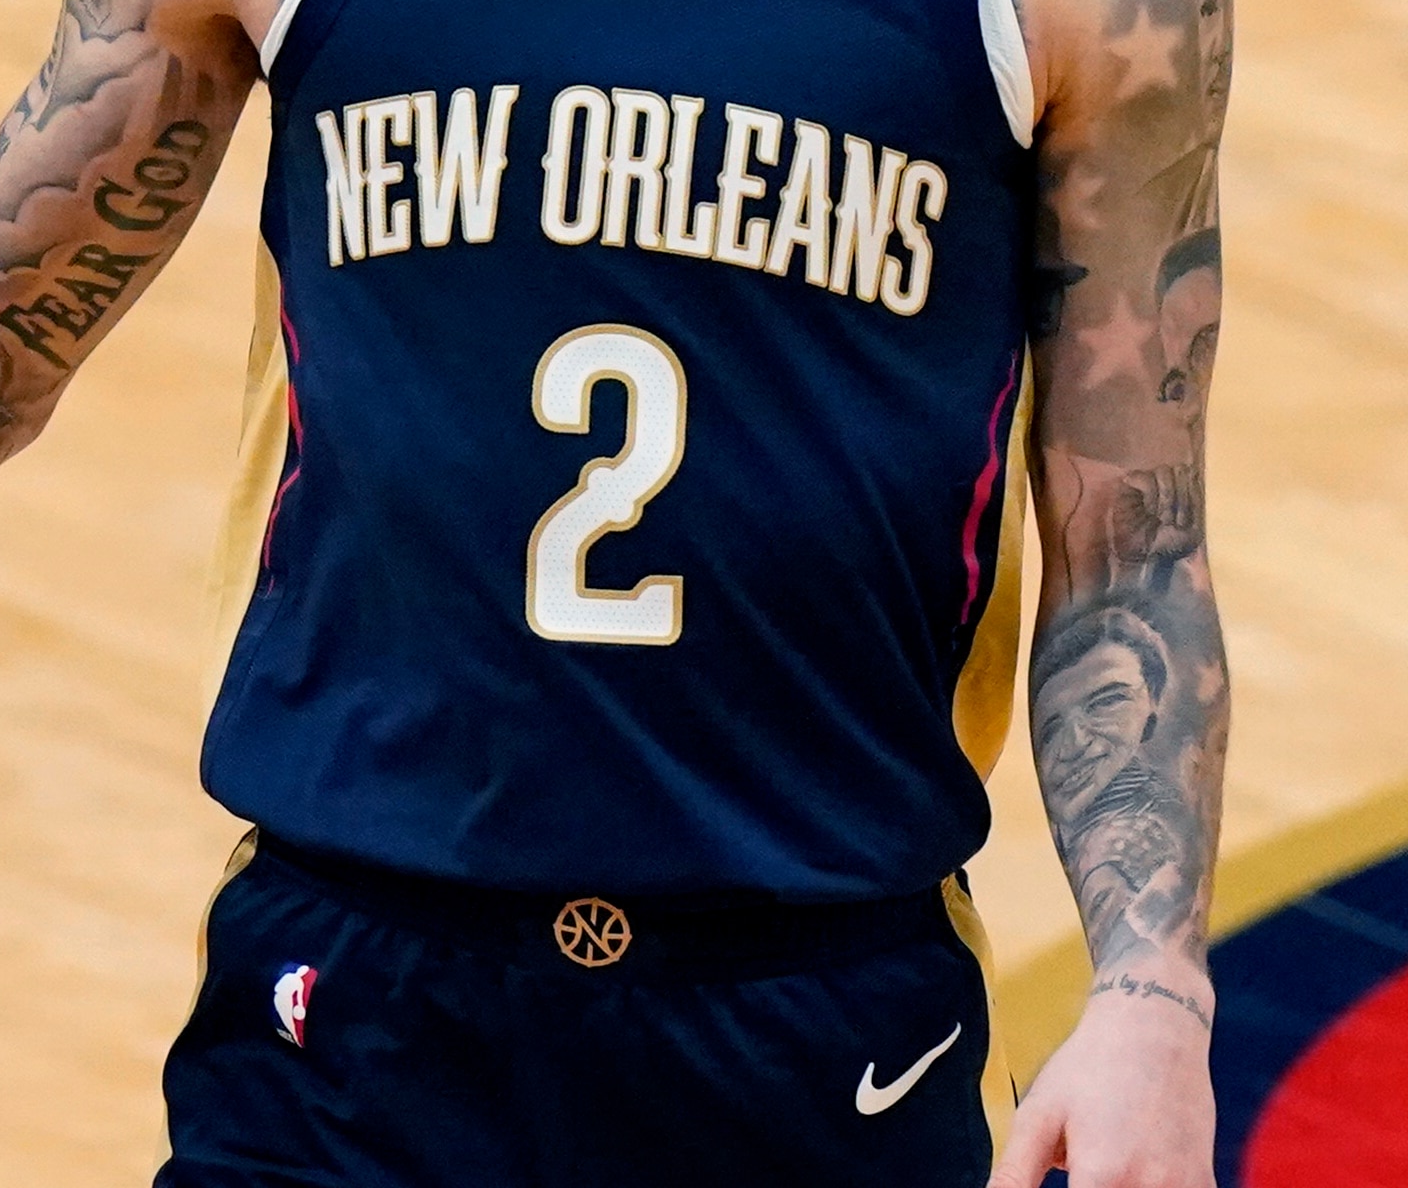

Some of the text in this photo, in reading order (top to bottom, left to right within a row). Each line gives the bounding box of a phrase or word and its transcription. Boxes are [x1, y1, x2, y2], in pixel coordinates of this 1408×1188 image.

[94, 120, 209, 231] GOD
[314, 84, 948, 318] NEW ORLEANS
[525, 323, 687, 646] 2
